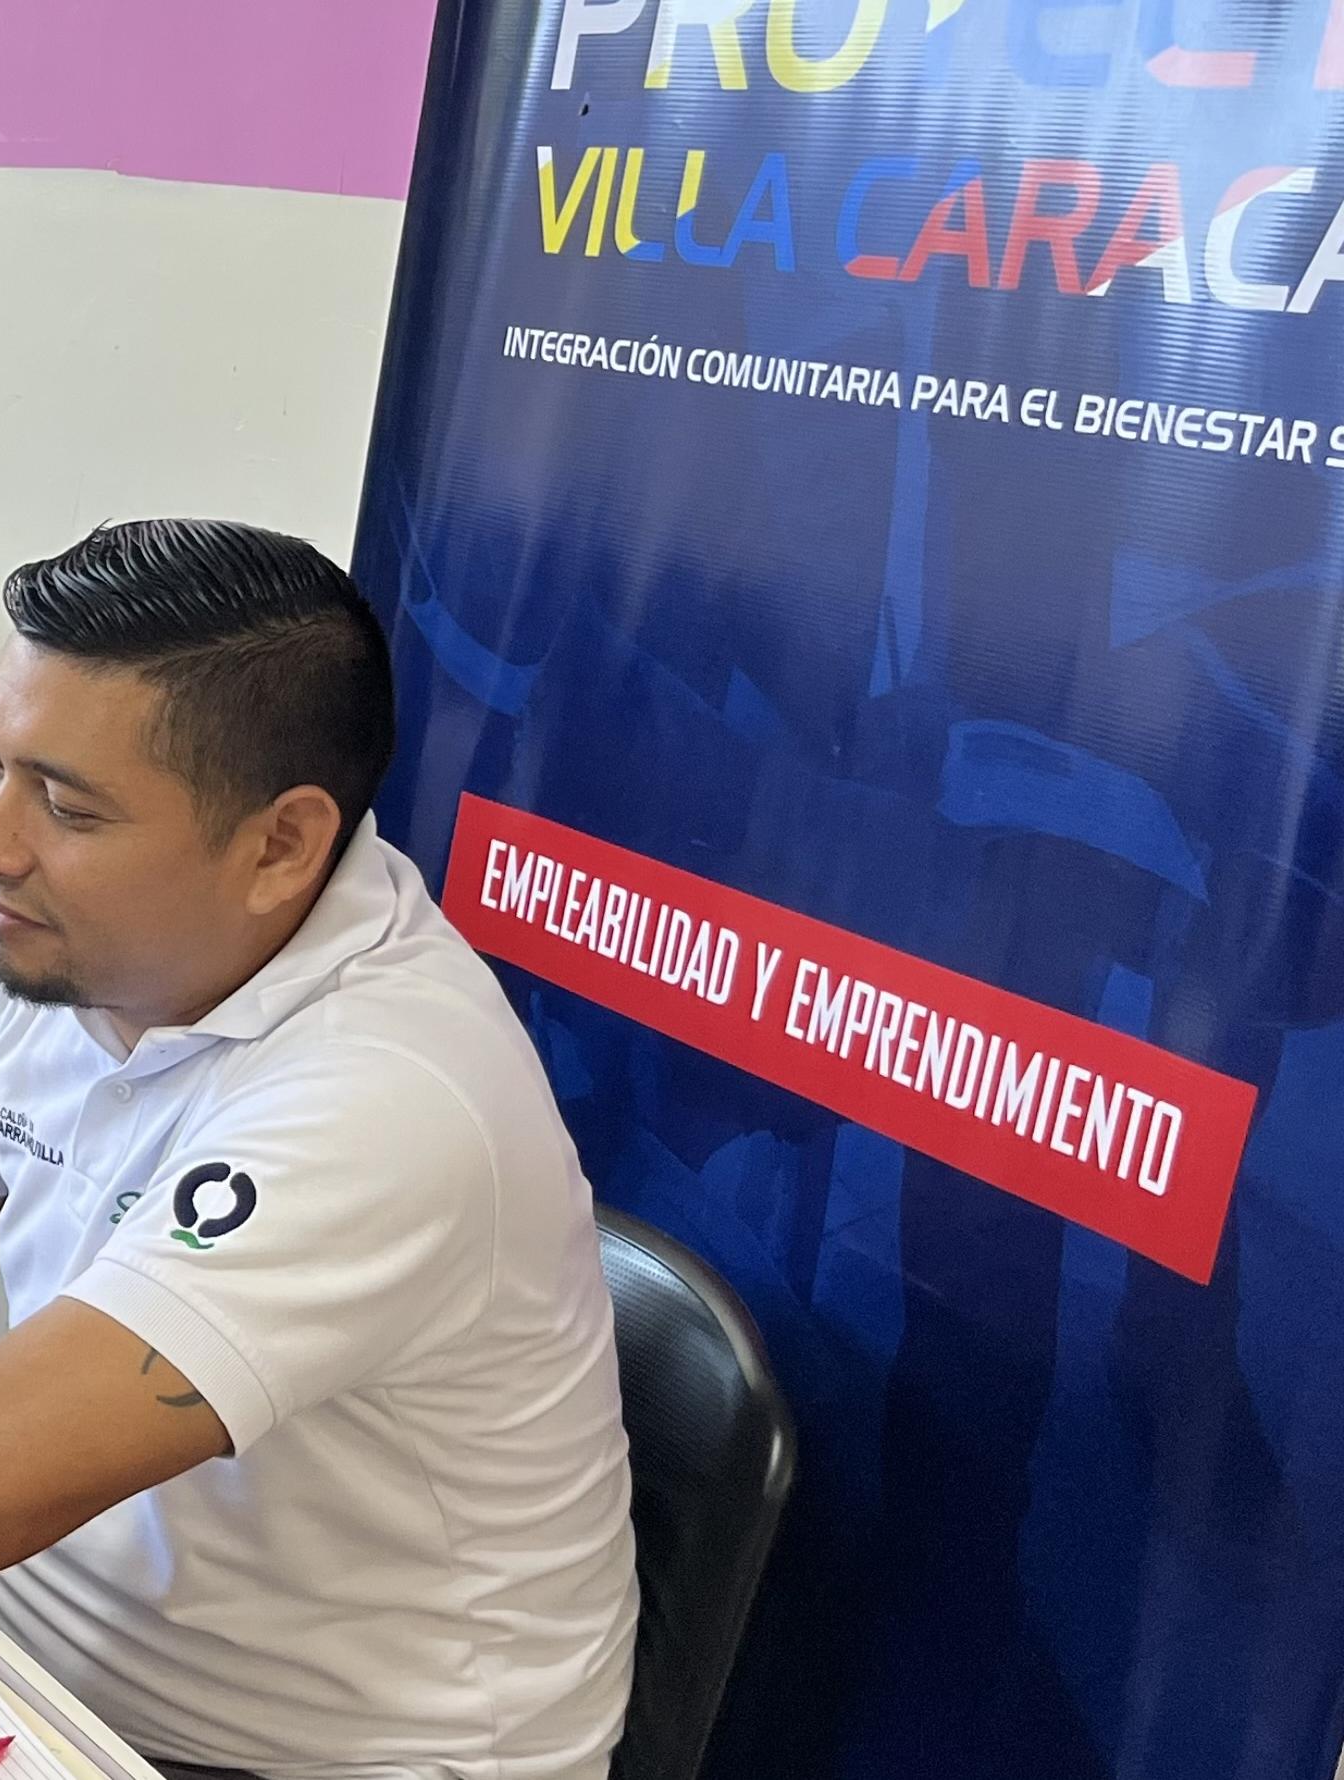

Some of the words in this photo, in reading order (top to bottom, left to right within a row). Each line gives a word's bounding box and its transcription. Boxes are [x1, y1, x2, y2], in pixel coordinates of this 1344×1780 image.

[537, 146, 795, 272] VILLA
[503, 326, 682, 379] INTEGRACIÓN
[686, 348, 901, 409] COMUNITARIA
[910, 375, 1009, 423] PARA
[1020, 388, 1063, 430] EL
[1074, 394, 1316, 464] BIENESTAR
[479, 838, 740, 1005] EMPLEABILIDAD
[751, 941, 783, 1021] Y
[784, 958, 1183, 1197] EMPRENDIMIENTO
